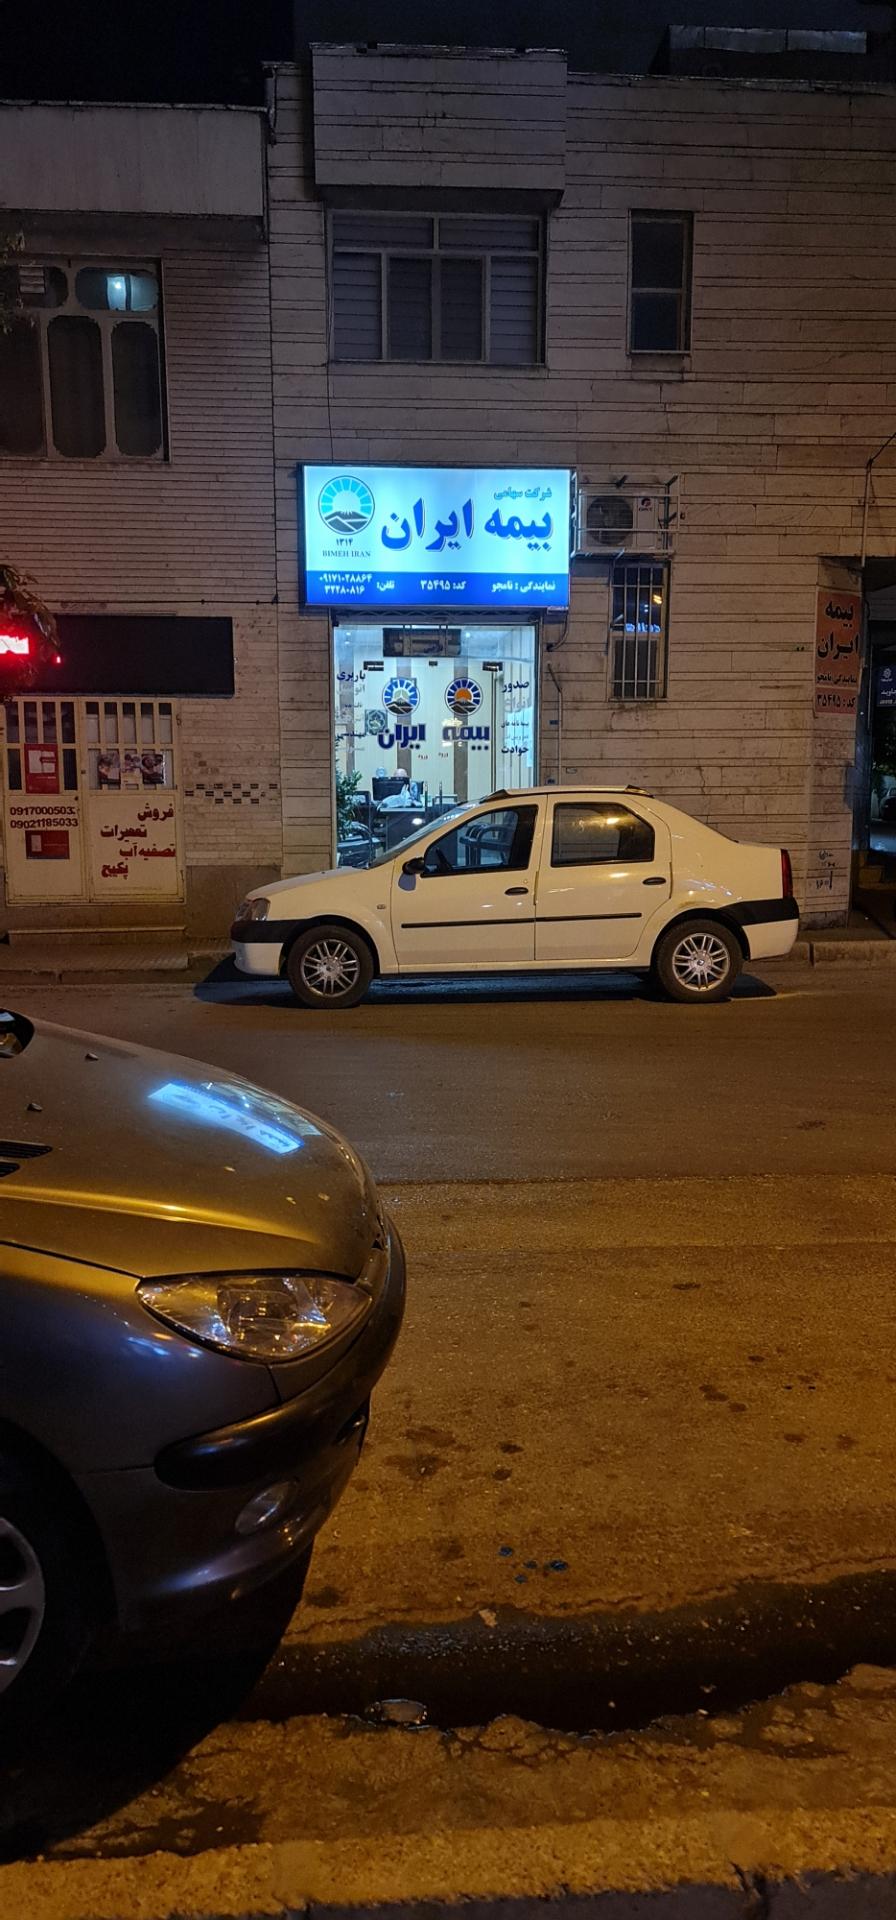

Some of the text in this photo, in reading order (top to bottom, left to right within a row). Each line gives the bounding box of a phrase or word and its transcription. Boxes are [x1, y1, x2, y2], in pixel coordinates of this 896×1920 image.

[493, 486, 553, 502] شرکت سهامی
[381, 498, 554, 552] بیمه ایران
[336, 537, 354, 547] ۱۳۱۴
[322, 550, 372, 558] BIMEH IRAN
[420, 580, 451, 591] ۳۵۴۹۵
[491, 580, 513, 593] نامجو
[520, 579, 556, 593] نمایندگی
[824, 600, 854, 628] بیمه
[817, 631, 859, 660] ایران
[336, 670, 366, 682] باربری
[501, 680, 530, 693] صدور
[377, 723, 490, 750] بیمه ایران
[137, 803, 175, 821] فروش
[10, 818, 79, 829] 09021185033
[100, 824, 148, 843] تعمیرات
[119, 842, 176, 862] تصفیه آب
[100, 860, 129, 880] پکیج
